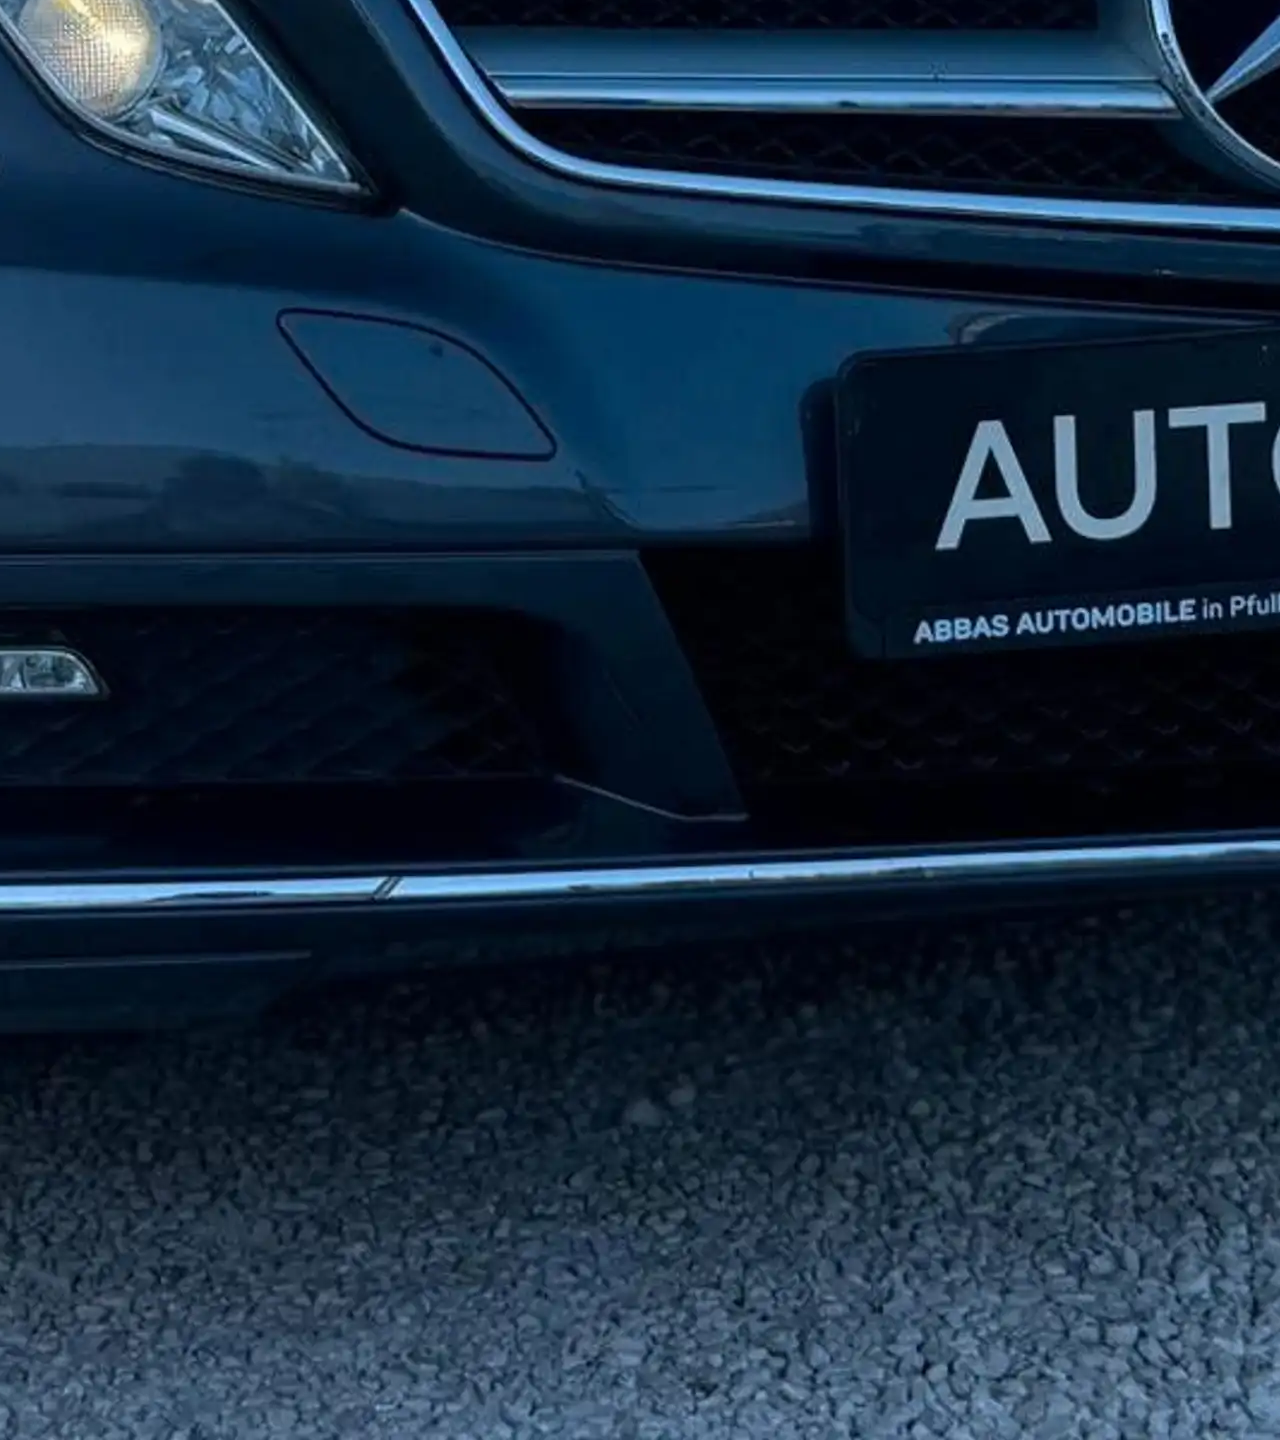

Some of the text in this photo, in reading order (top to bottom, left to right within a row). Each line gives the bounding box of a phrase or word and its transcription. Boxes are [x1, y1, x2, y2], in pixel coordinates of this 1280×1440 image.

[913, 614, 1010, 644] ABBAS
[1016, 599, 1196, 635] AUTOMOBILE
[1202, 597, 1223, 620] in
